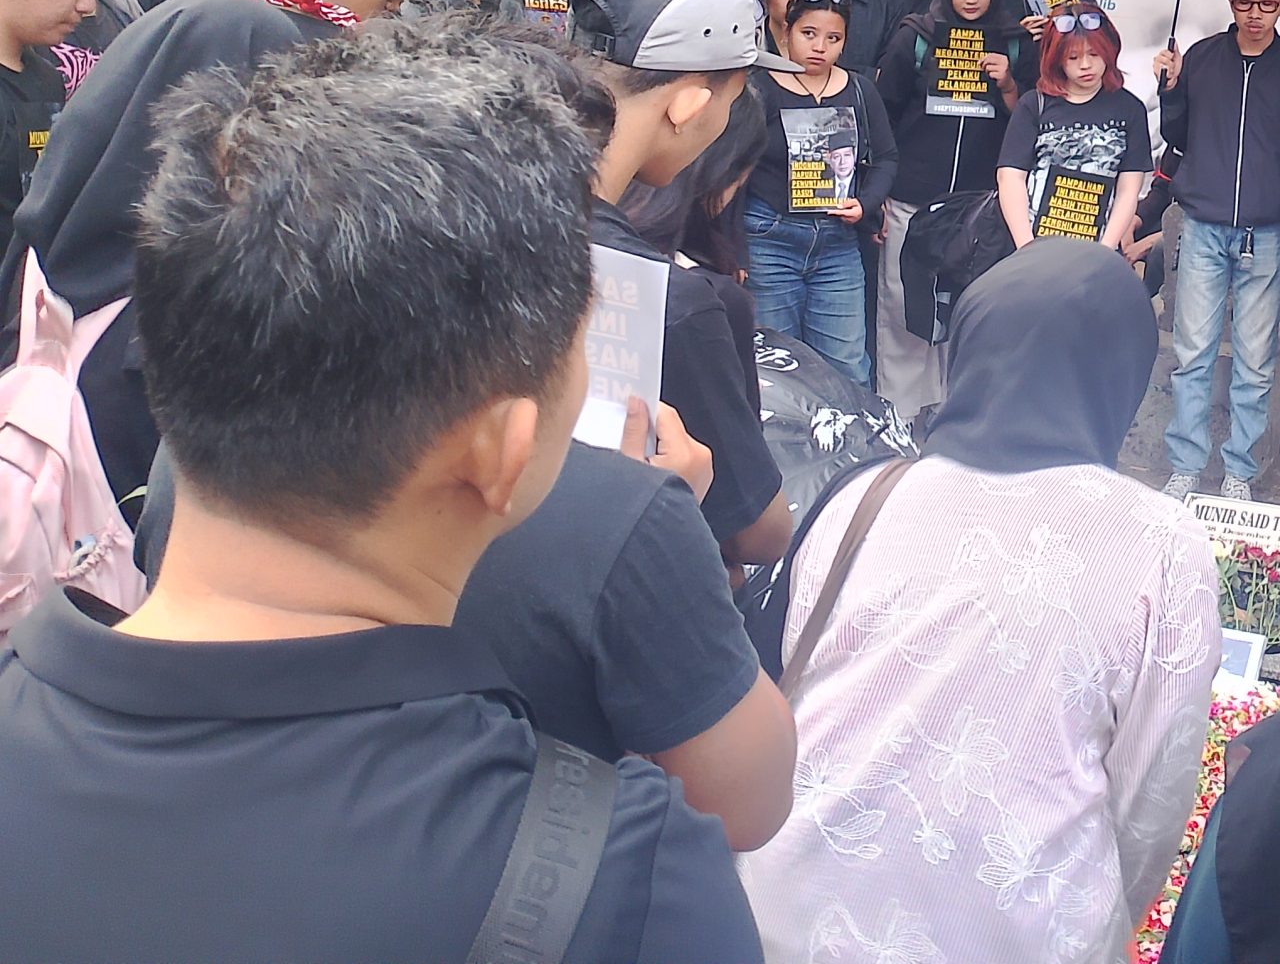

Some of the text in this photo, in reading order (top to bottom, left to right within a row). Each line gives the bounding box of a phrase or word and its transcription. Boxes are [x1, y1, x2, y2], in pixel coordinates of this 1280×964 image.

[950, 28, 984, 40] SAMPAI
[947, 70, 980, 81] PELAKU
[938, 80, 988, 92] PELANGGAR
[952, 91, 972, 102] HAM
[792, 161, 826, 171] INDONESIA
[792, 170, 822, 180] DARURAT
[1055, 176, 1104, 194] SAMPAI HARI
[1069, 189, 1099, 204] NEGARA
[1049, 196, 1100, 215] MASIH TERUS
[1048, 206, 1096, 225] MELAKUKAN
[1039, 215, 1098, 236] PENGHILANGAN
[1195, 504, 1237, 525] MUNIR
[1238, 510, 1270, 530] SAID
